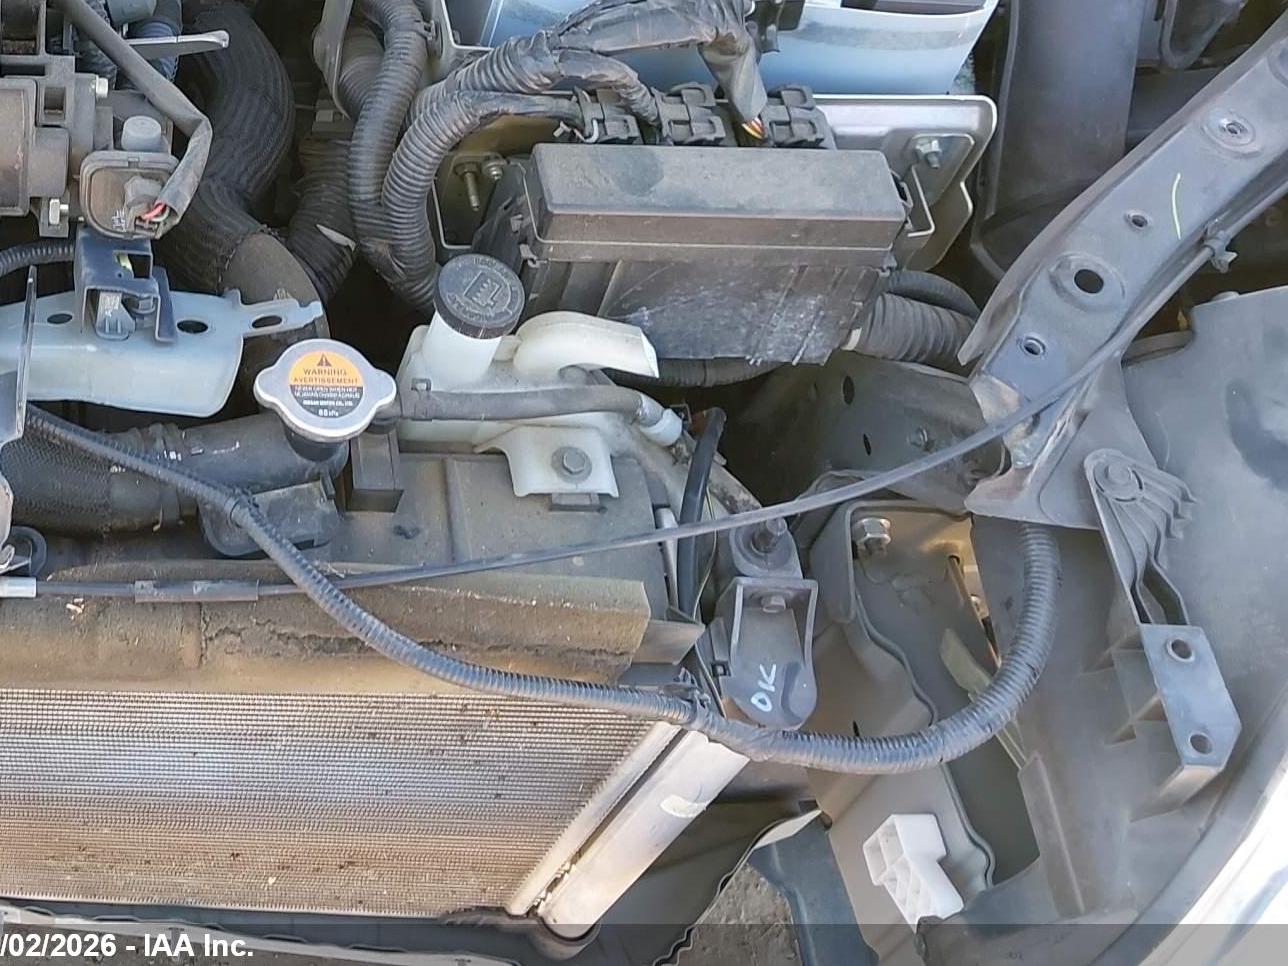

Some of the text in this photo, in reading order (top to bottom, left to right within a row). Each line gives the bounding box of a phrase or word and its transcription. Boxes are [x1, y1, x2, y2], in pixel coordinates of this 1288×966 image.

[303, 369, 348, 377] WARNING
[293, 376, 359, 385] AVERTISSEMENT
[750, 663, 777, 713] OK
